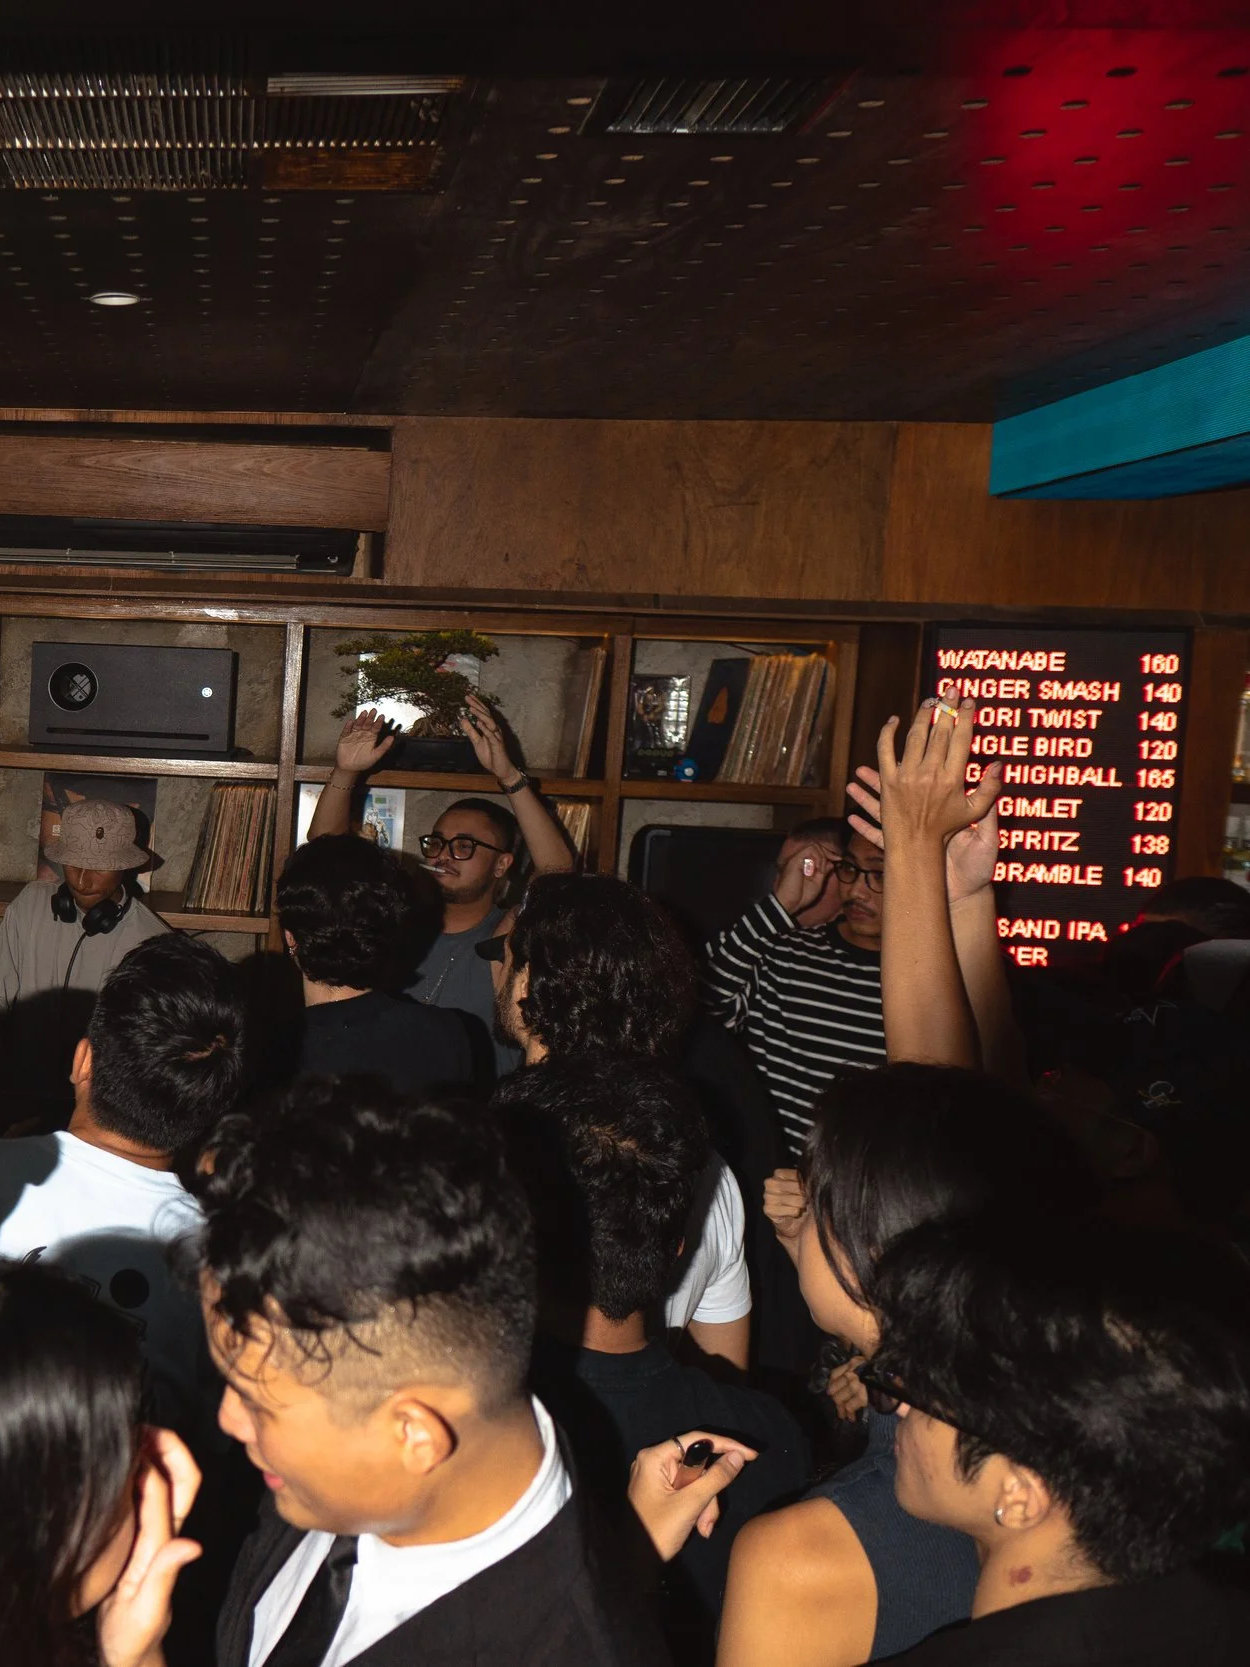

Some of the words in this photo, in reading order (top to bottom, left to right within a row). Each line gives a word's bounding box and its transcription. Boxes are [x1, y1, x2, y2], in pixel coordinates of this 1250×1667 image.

[937, 649, 1066, 672] WATANABE
[1140, 653, 1179, 674] 160
[1038, 680, 1121, 702] SMASH
[1143, 682, 1183, 703] 140
[1027, 708, 1103, 730] TWIST
[1138, 711, 1178, 732] 140
[1033, 736, 1093, 758] BIRD
[1138, 740, 1178, 760] 120
[1003, 763, 1123, 787] HIGHBALL
[1136, 768, 1176, 789] 165
[997, 796, 1083, 819] GIMLET
[1133, 801, 1173, 822] 120
[998, 829, 1081, 852] SPRITZ
[1131, 834, 1170, 855] 138
[992, 861, 1103, 886] BRAMBLE
[1123, 867, 1162, 888] 140
[997, 917, 1061, 940] SAND
[1067, 920, 1108, 942] IPA
